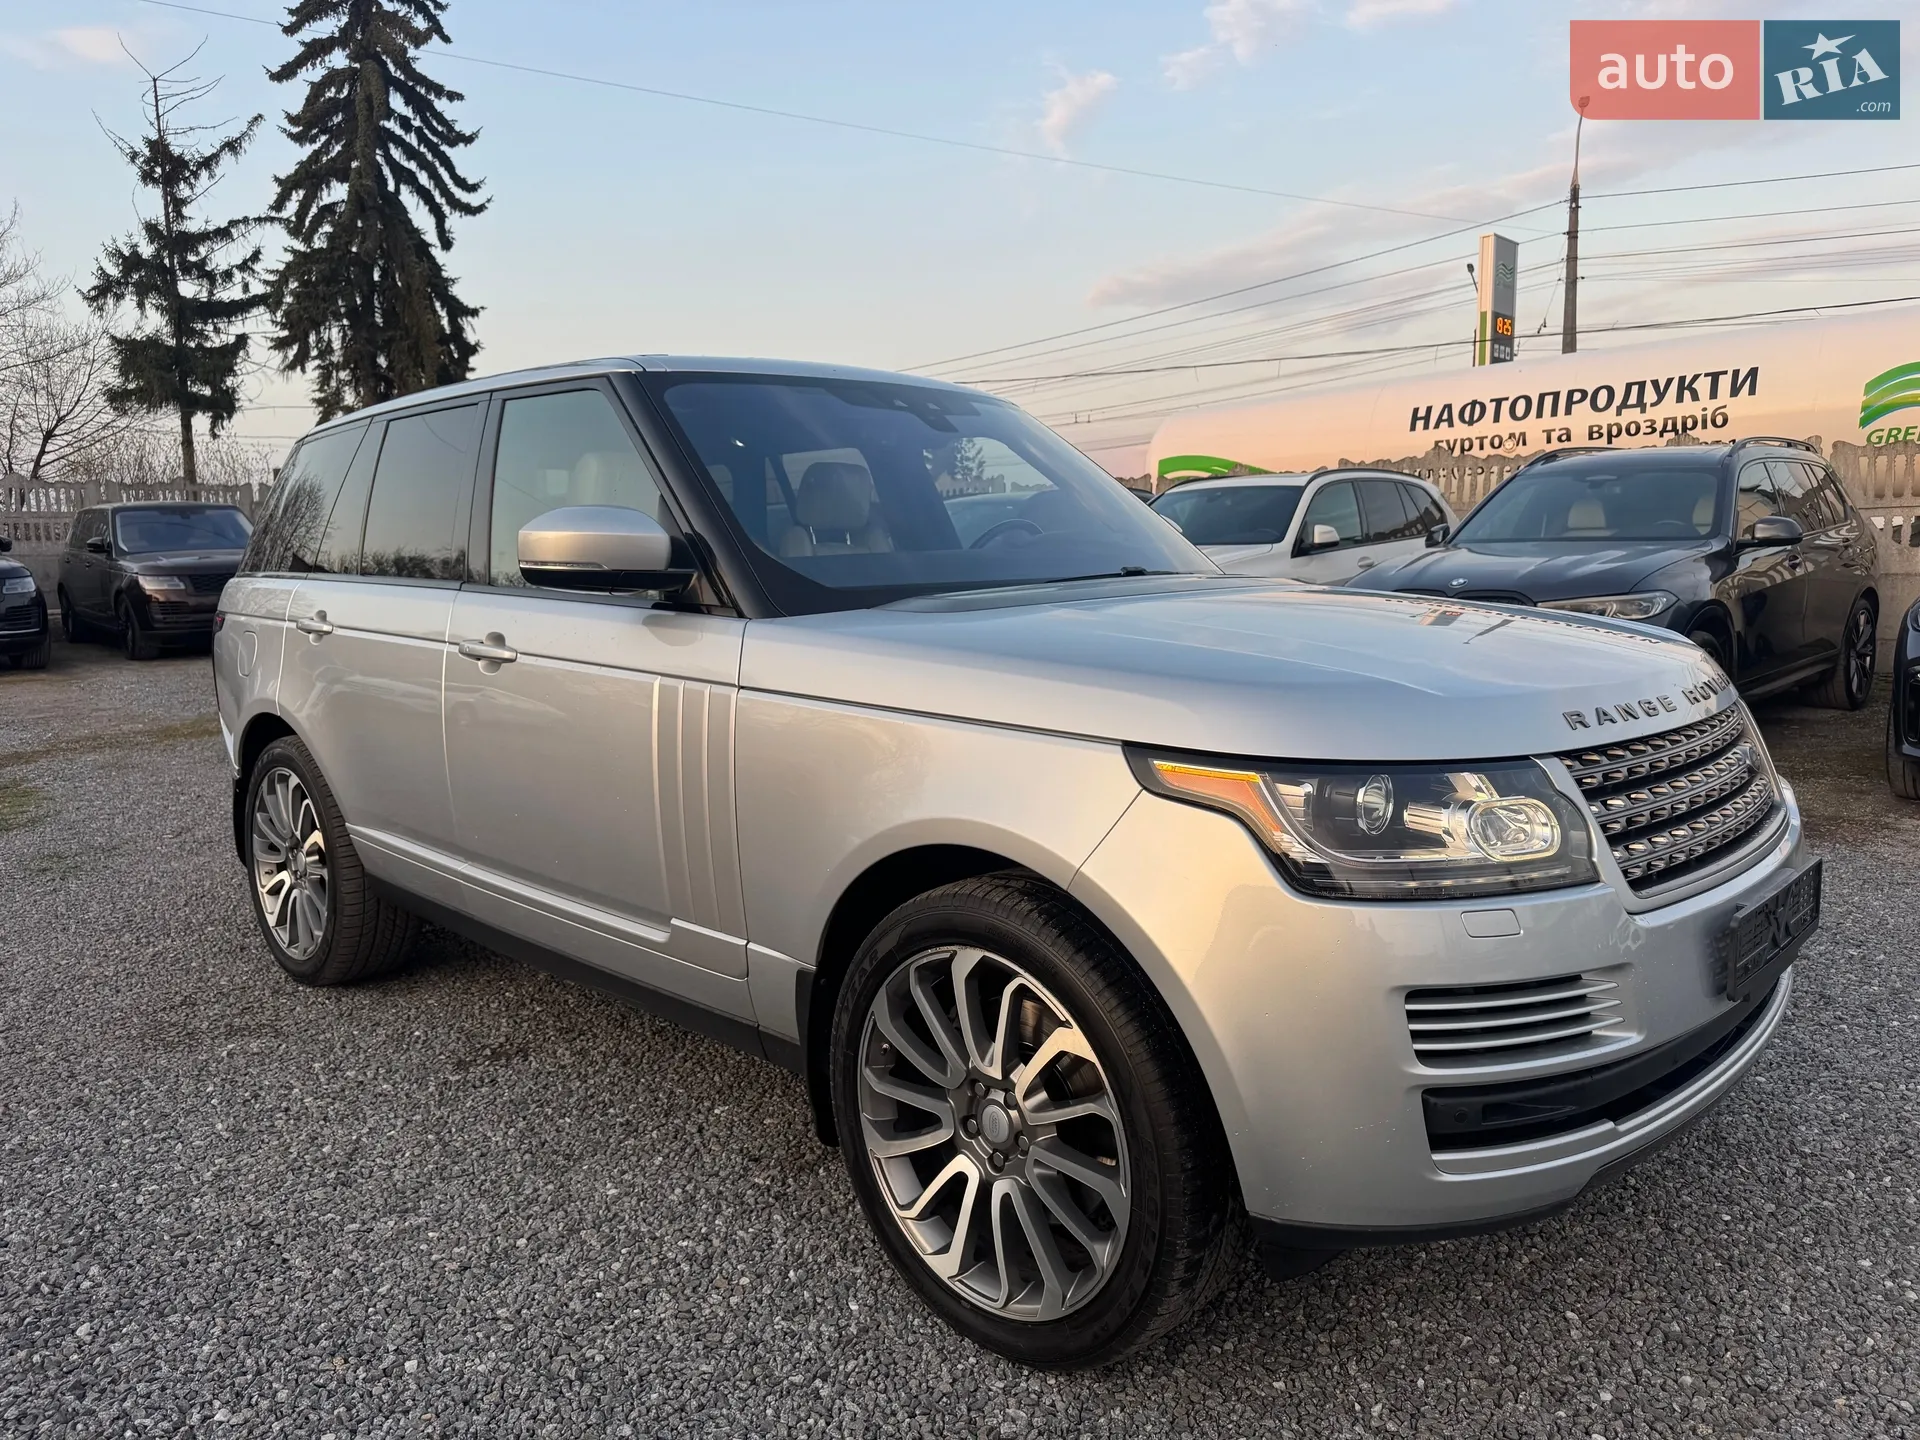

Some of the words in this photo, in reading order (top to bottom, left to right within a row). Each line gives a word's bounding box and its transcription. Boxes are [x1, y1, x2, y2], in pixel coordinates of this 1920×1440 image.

[1409, 366, 1759, 432] НАФТОПРОДУКТИ
[1542, 424, 1573, 444] та
[1587, 404, 1730, 446] вроздріб
[1865, 425, 1920, 446] GRE
[1562, 694, 1677, 731] RANGE
